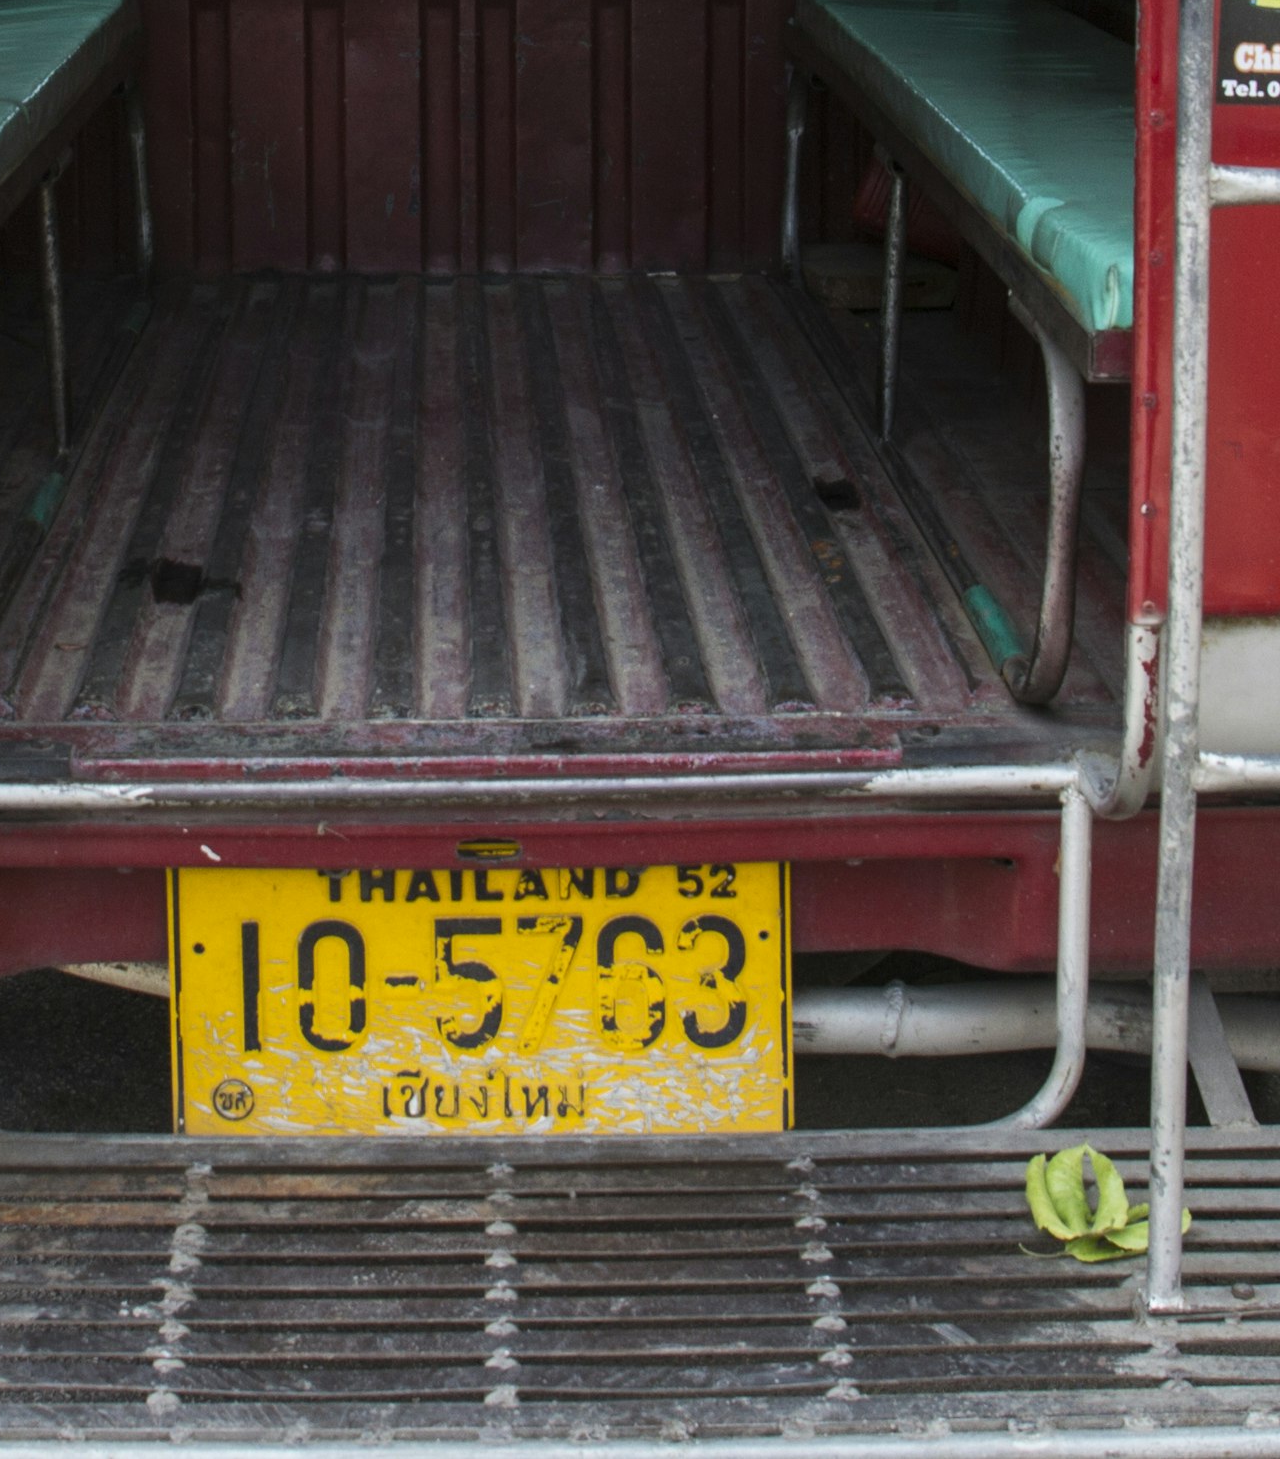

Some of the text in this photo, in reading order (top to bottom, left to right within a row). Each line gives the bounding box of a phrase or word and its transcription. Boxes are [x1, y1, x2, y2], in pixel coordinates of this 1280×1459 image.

[1221, 79, 1265, 98] Tel.
[317, 865, 738, 903] THAILAND 52
[241, 913, 748, 1053] 10-5763
[382, 1067, 586, 1118] เชียงใหม่
